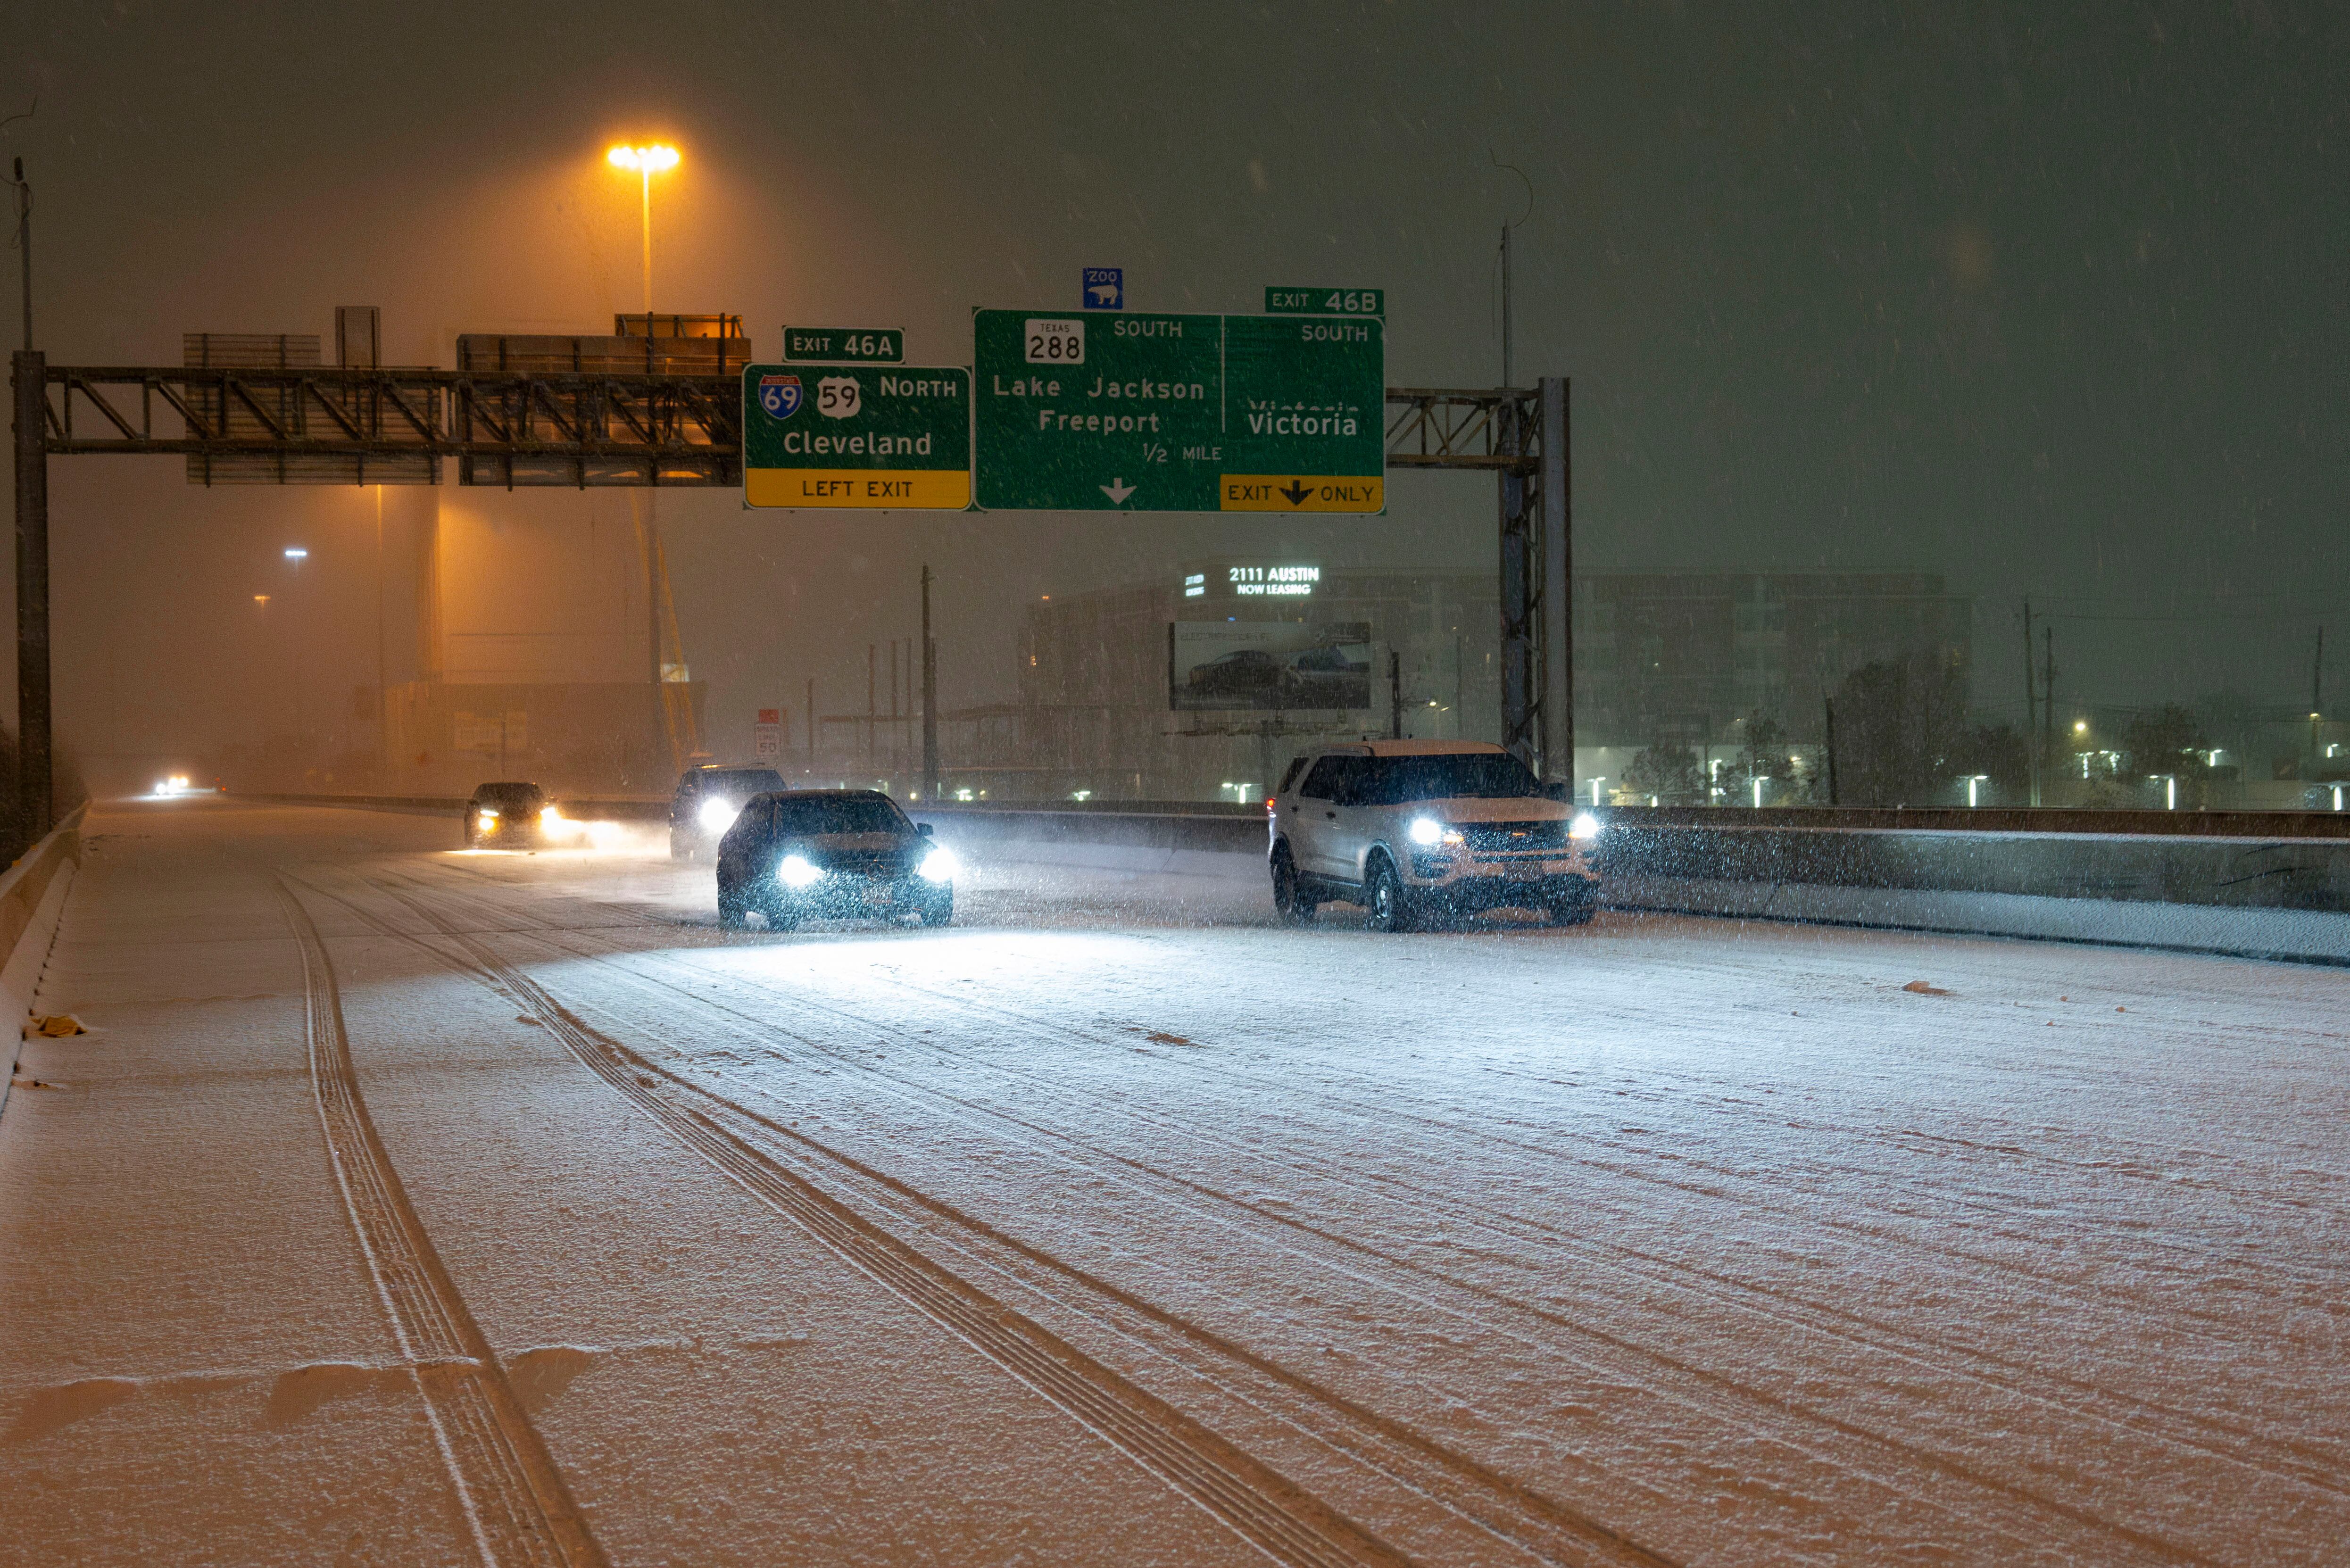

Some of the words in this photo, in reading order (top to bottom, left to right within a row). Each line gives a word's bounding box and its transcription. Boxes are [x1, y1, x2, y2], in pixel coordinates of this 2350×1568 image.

[1088, 271, 1117, 282] ZOO
[1273, 293, 1309, 307] EXIT
[1325, 292, 1377, 311] 46B
[1040, 324, 1070, 332] TEXAS
[1114, 320, 1182, 338] SOUTH
[1302, 325, 1368, 342] SOUTH
[793, 337, 830, 352] EXIT
[844, 335, 893, 356] 46A
[1030, 335, 1080, 359] 288
[880, 377, 956, 397] NORTH
[994, 375, 1061, 397] Lake
[1087, 377, 1204, 399] Jackson
[764, 387, 797, 410] 69
[822, 385, 856, 408] 59
[1039, 410, 1159, 436] Freeport
[1248, 412, 1357, 436] Victoria
[784, 431, 931, 455] Cleveland
[1182, 446, 1222, 461] MILE
[803, 481, 854, 497] LEFT
[868, 481, 913, 498] EXIT
[1229, 485, 1272, 500] EXIT
[1321, 486, 1374, 502] ONLY
[1229, 567, 1263, 581] 2111
[1267, 567, 1319, 582] AUSTIN
[1237, 584, 1265, 595] NOW
[1266, 584, 1312, 595] LEASING
[760, 742, 776, 753] 50
